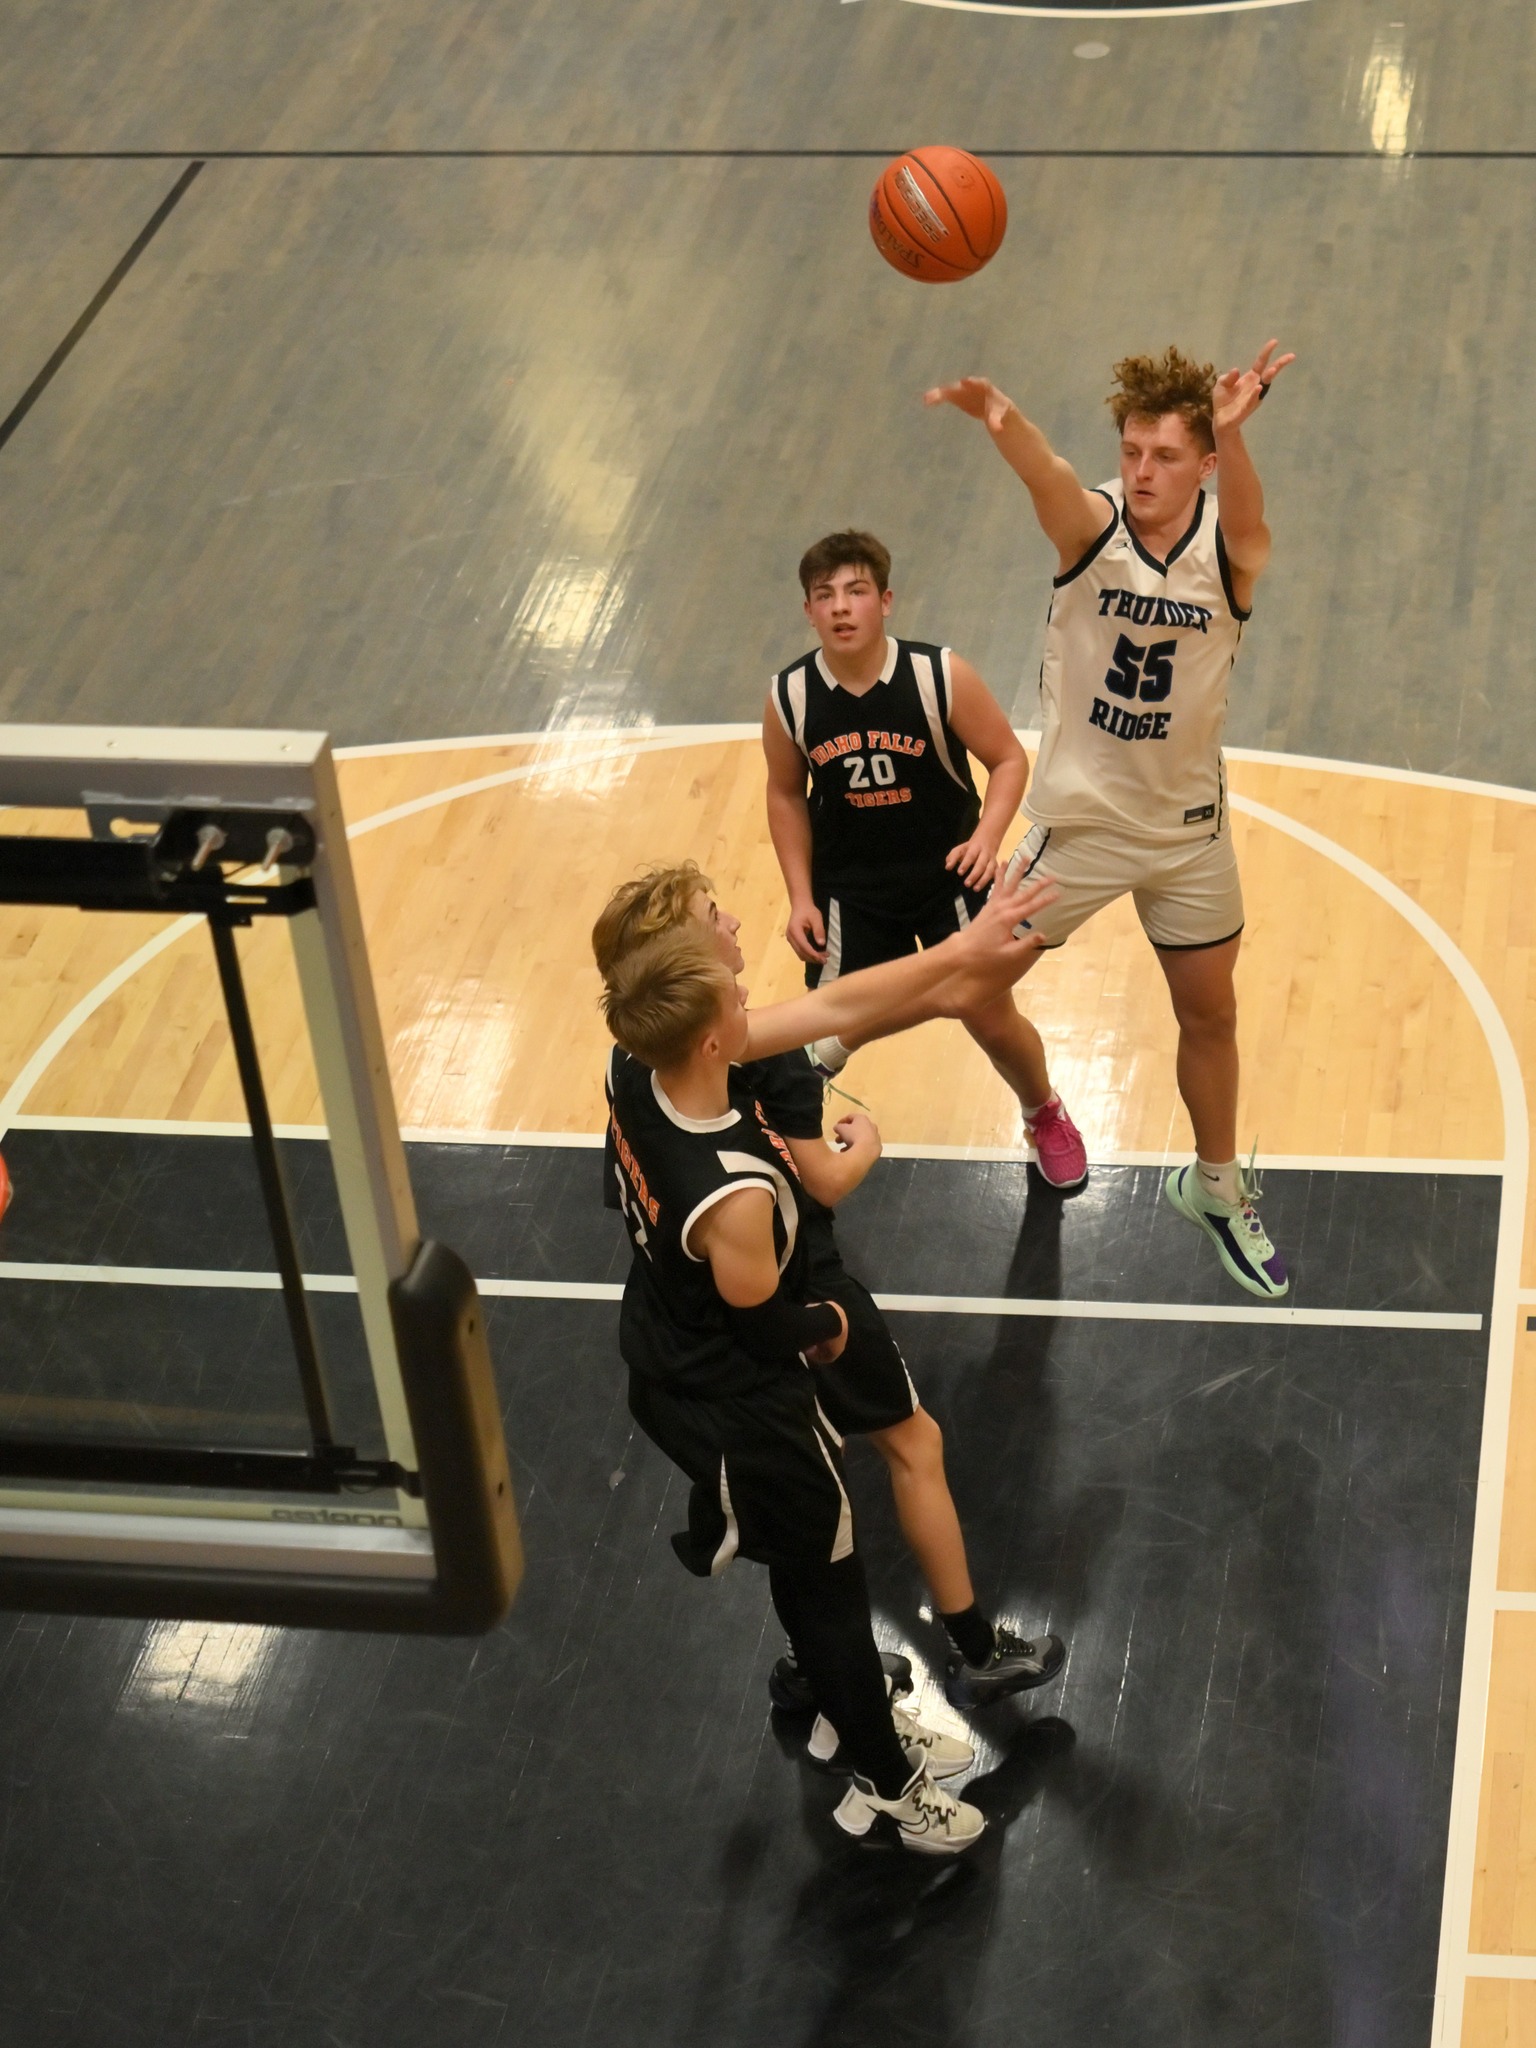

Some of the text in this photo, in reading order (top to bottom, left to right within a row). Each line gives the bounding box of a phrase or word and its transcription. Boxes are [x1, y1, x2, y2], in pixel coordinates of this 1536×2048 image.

[869, 188, 925, 269] SPALD
[1098, 588, 1213, 634] THUNDER
[1104, 633, 1178, 702] 55
[1089, 697, 1172, 741] RIDGE
[810, 730, 926, 766] IDAHO FALLS
[843, 754, 896, 789] 20
[845, 787, 912, 808] TIGERS
